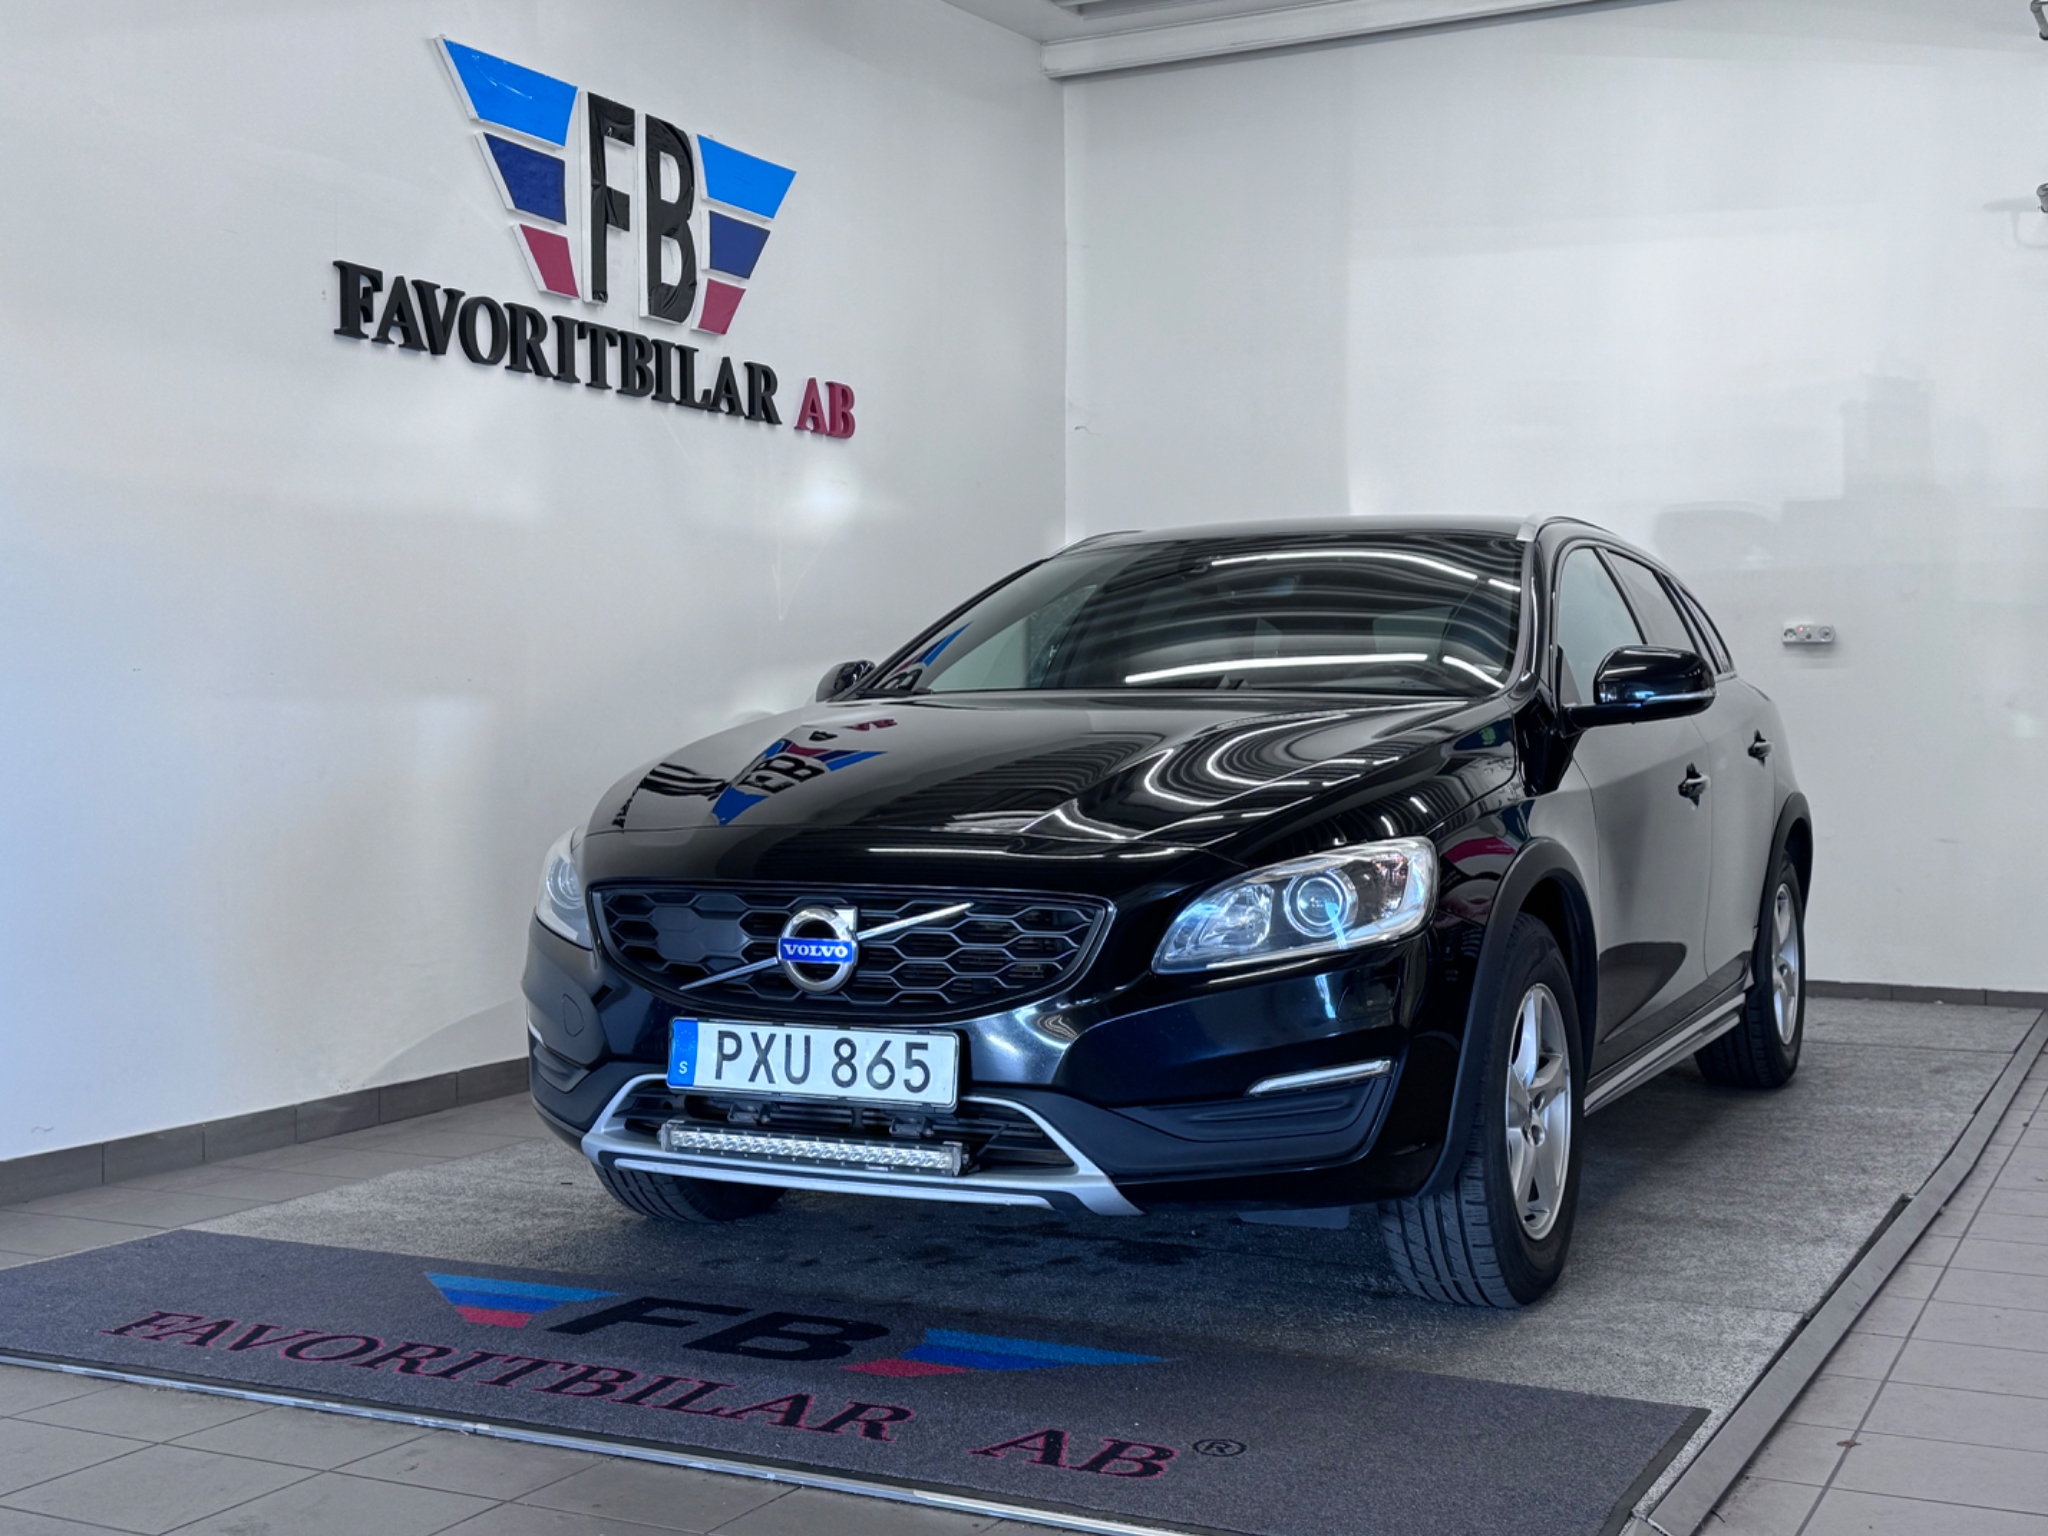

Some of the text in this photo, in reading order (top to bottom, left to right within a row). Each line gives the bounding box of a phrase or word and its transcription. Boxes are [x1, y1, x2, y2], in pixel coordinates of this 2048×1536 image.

[578, 90, 698, 325] FB
[332, 259, 857, 439] FAVORITBILAR AB
[782, 943, 849, 958] VOLVO
[678, 1060, 688, 1075] S
[714, 1030, 931, 1094] PXU 865
[547, 1297, 890, 1361] FB
[102, 1310, 915, 1442] FAVORITBILAR
[967, 1428, 1178, 1480] AB
